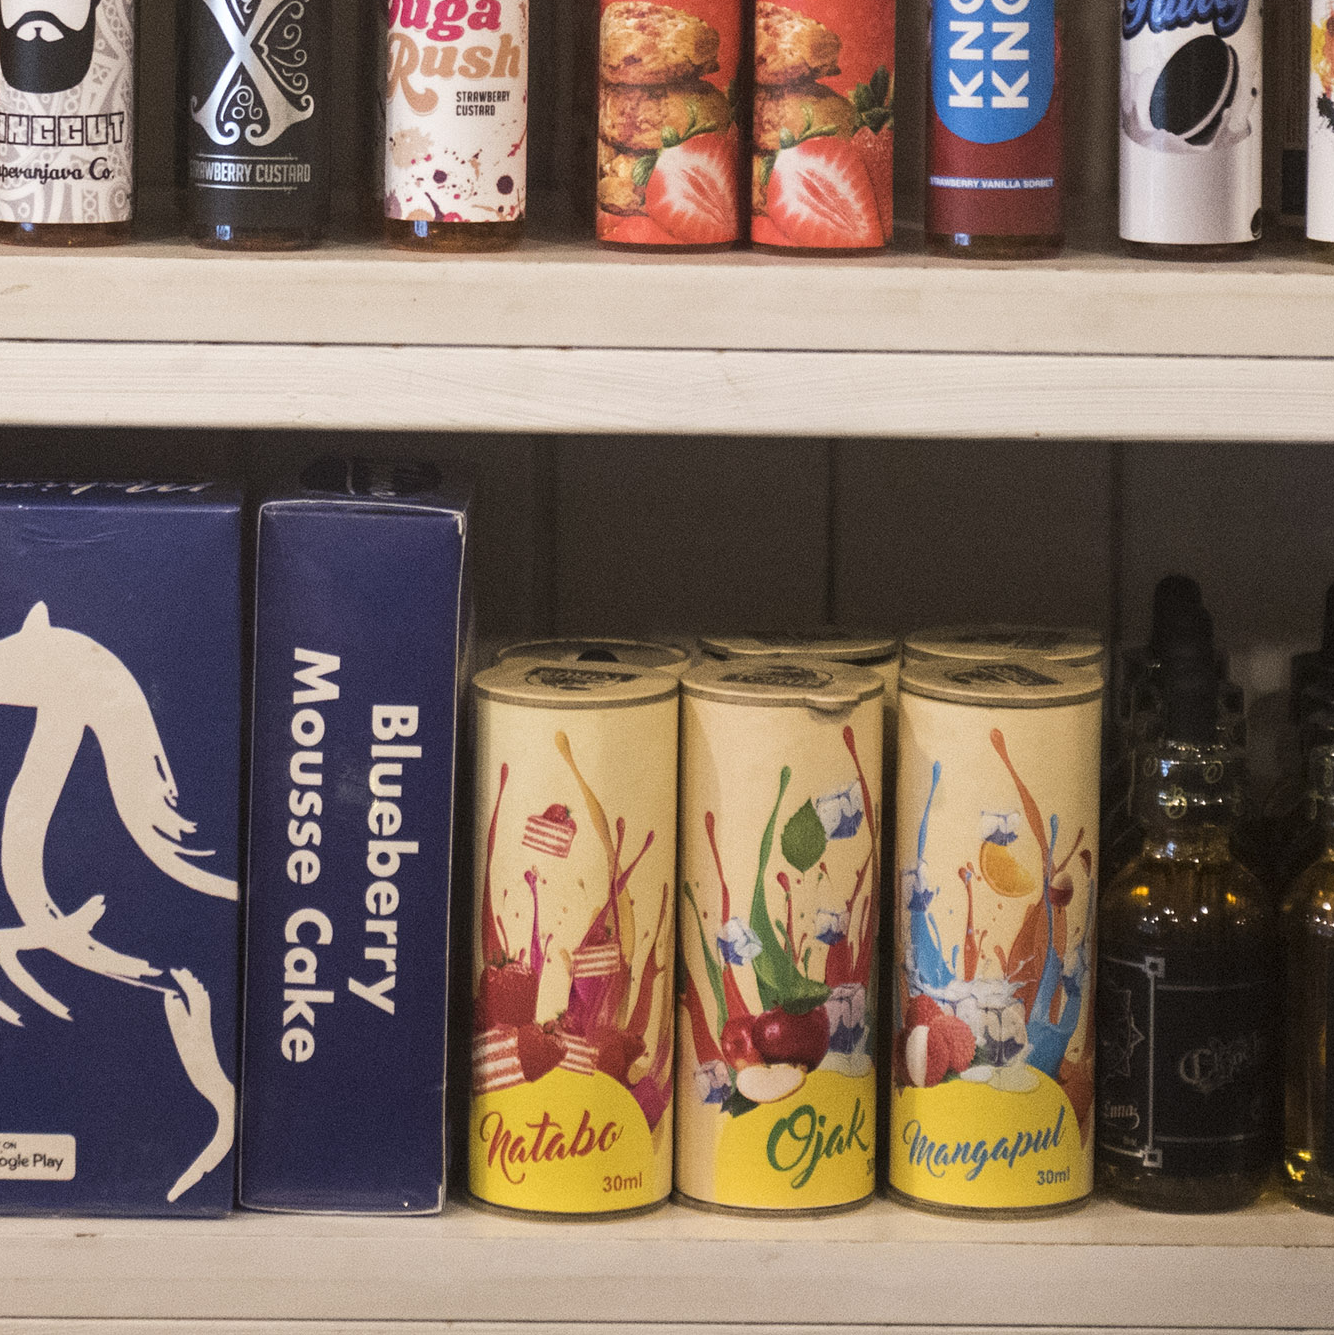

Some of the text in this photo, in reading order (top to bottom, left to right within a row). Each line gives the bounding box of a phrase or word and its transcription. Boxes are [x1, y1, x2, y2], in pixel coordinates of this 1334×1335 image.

[387, 33, 522, 117] Rush
[456, 91, 511, 103] STRAWBERRY
[456, 106, 496, 118] CUSTARD
[89, 156, 115, 181] Co.
[255, 163, 311, 183] CUSTARD
[981, 178, 1021, 189] VANILLA
[280, 647, 342, 1064] Mousse Cake
[348, 703, 423, 1016] Blueberry
[2, 1141, 17, 1150] ON
[480, 1110, 624, 1185] Natabo
[767, 1098, 869, 1190] Ojak
[903, 1104, 1067, 1183] Mangapul
[33, 1153, 64, 1172] Play
[602, 1171, 643, 1193] 30ml
[1036, 1167, 1071, 1186] 30ml
